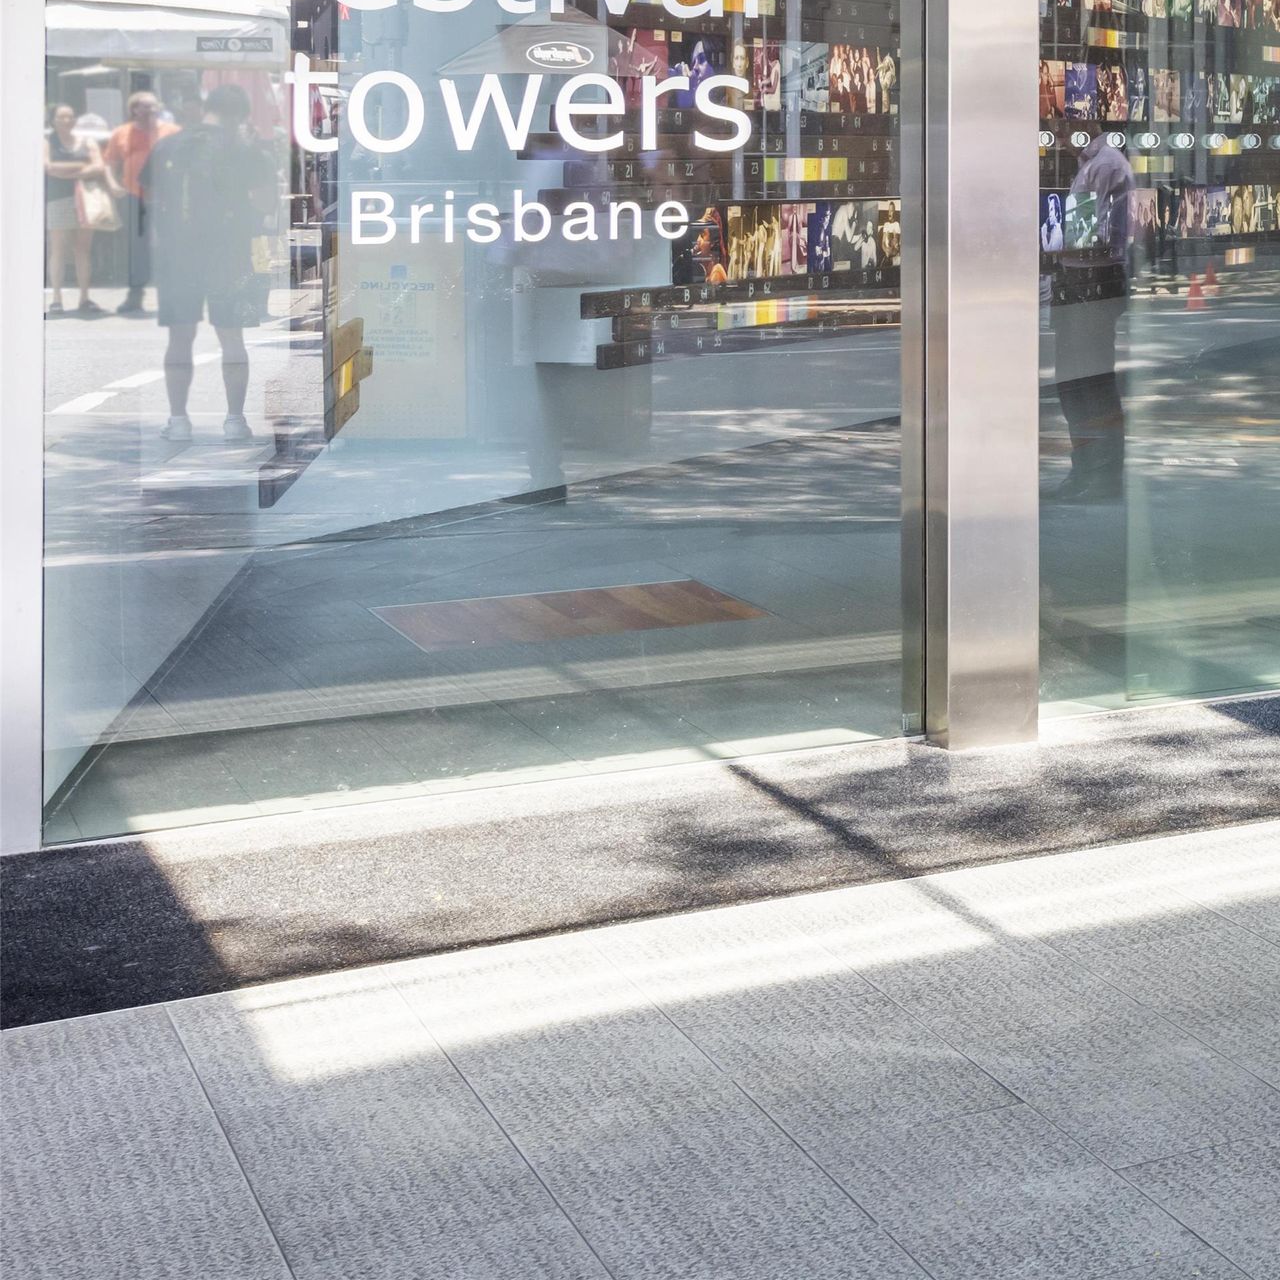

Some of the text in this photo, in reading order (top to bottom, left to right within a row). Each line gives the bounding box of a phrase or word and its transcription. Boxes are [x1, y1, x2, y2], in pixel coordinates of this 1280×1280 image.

[285, 52, 752, 154] towers
[626, 164, 633, 178] 21
[685, 163, 694, 177] 22
[752, 162, 759, 175] 23
[351, 190, 689, 246] Brisbane
[641, 292, 650, 306] 60
